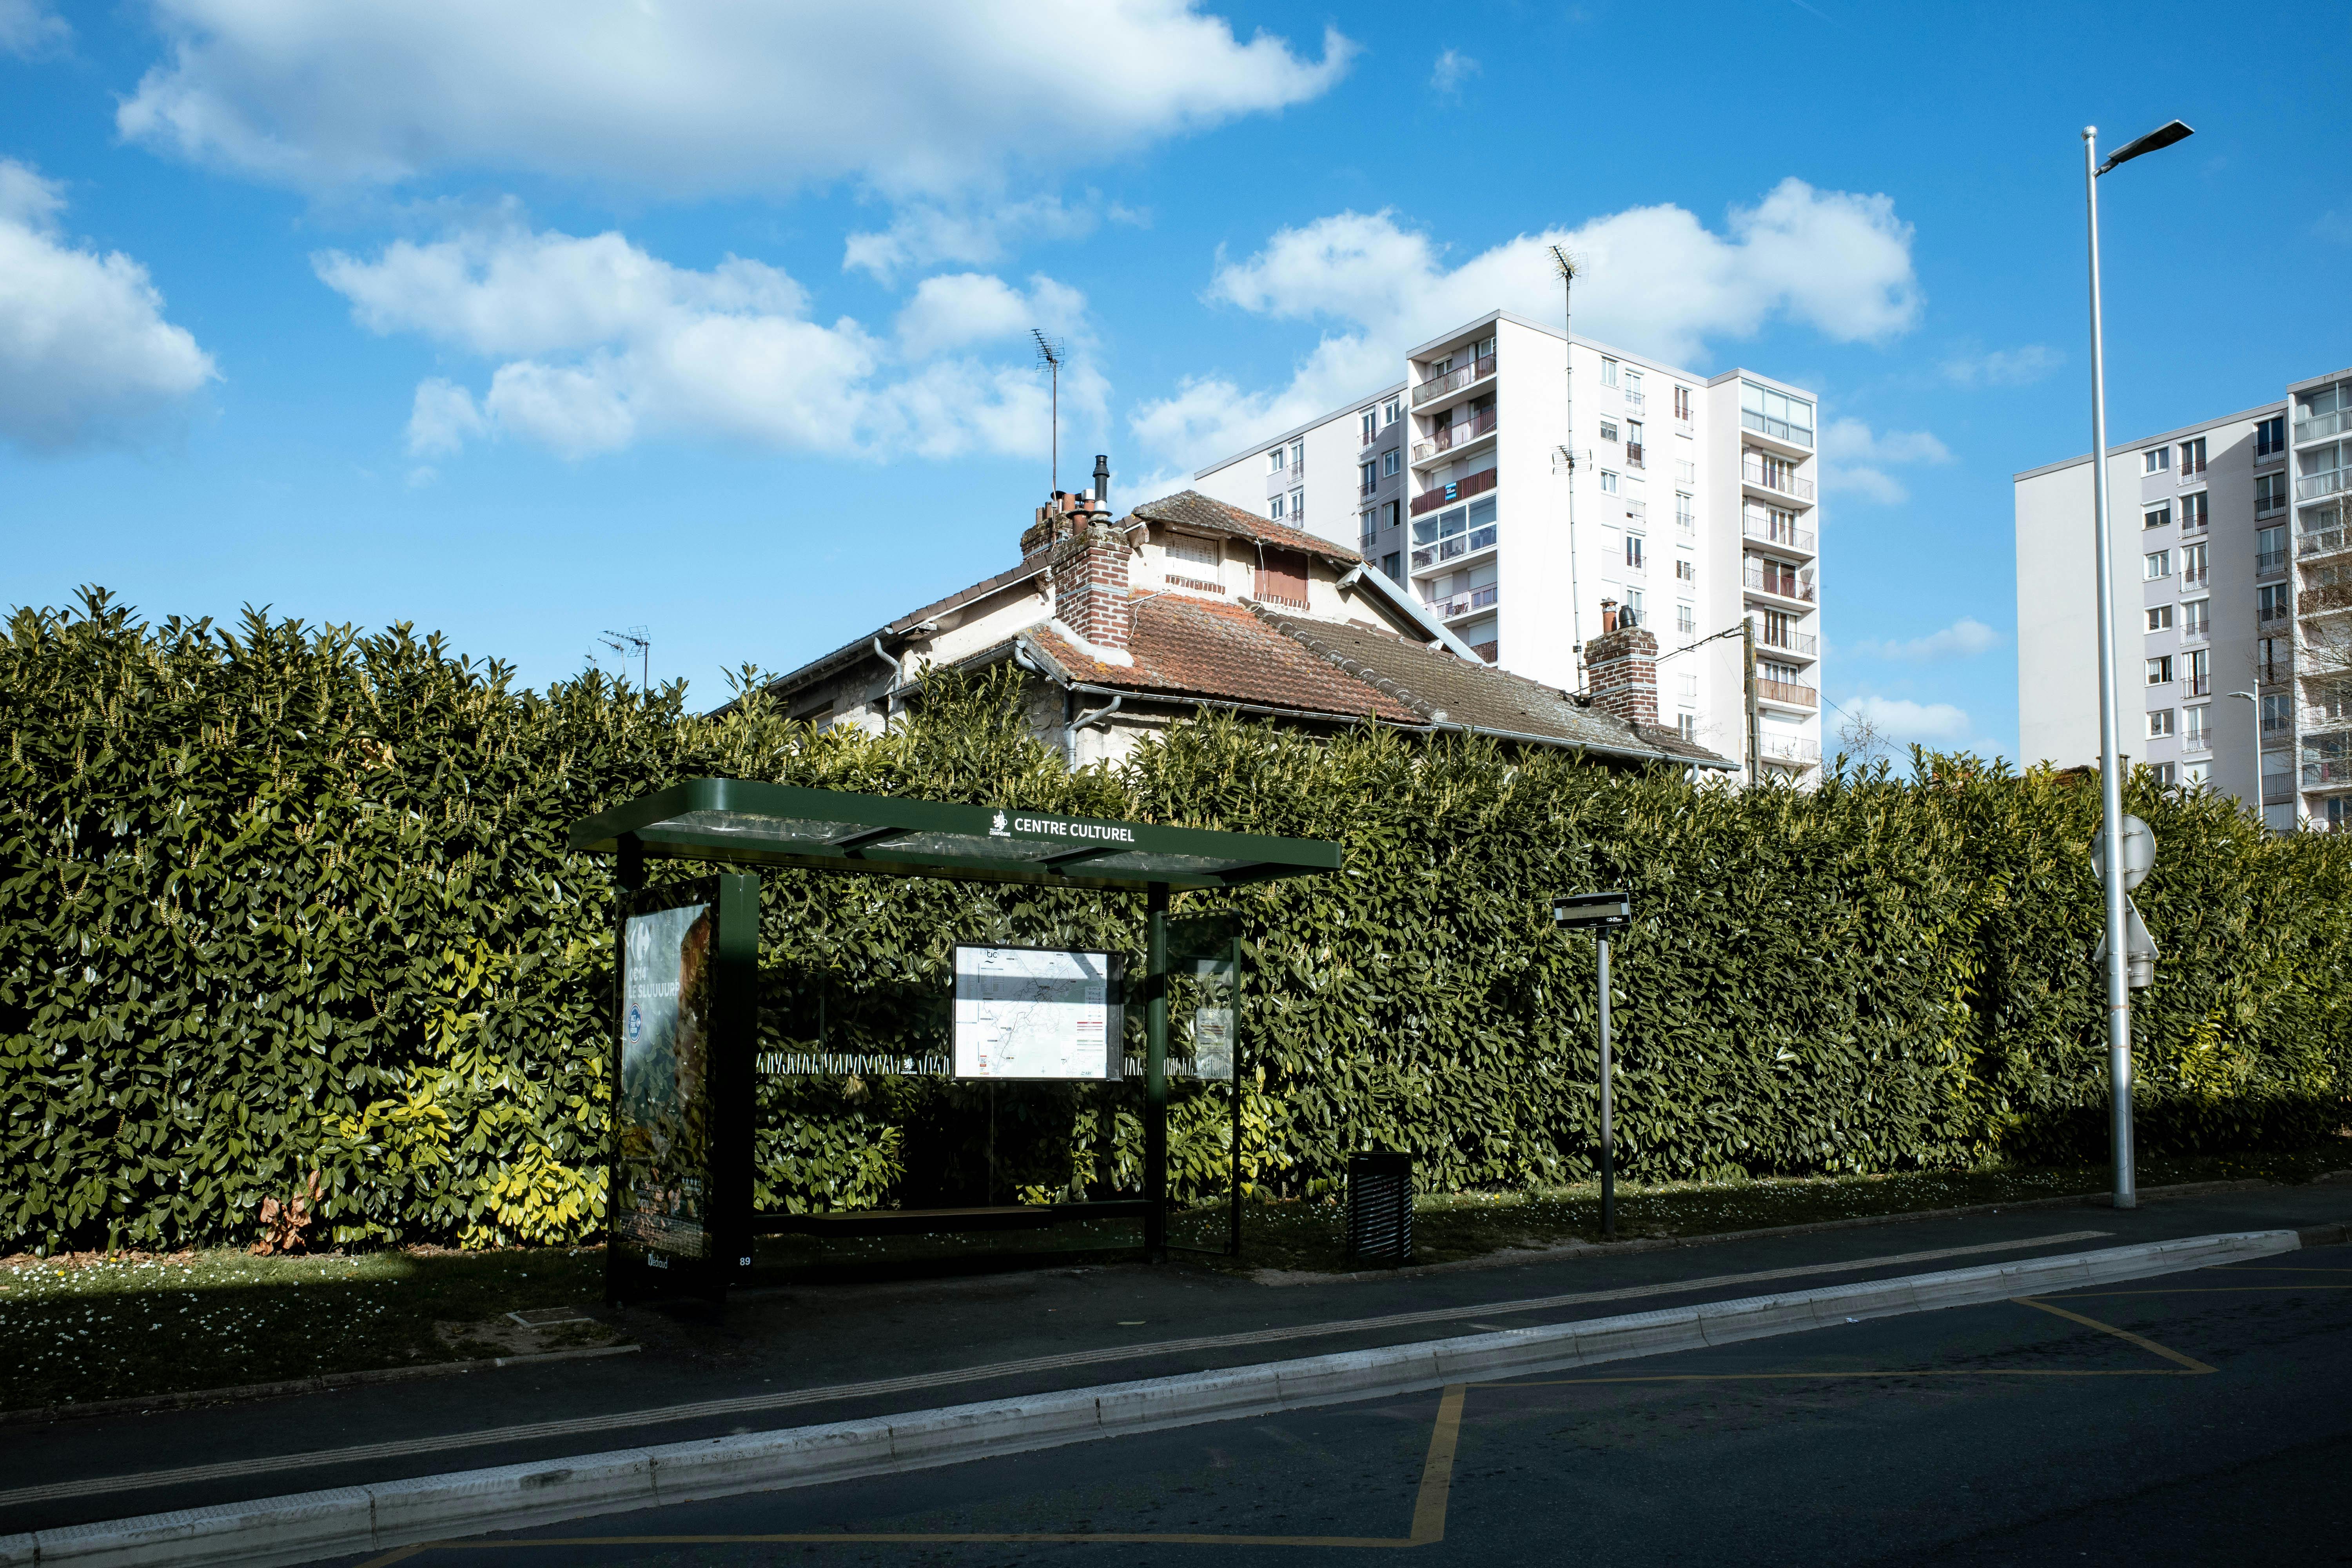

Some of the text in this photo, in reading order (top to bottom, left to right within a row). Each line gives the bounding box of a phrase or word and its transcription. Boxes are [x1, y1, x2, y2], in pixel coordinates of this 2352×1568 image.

[1014, 818, 1135, 842] CENTRE CULTUREL
[628, 982, 680, 999] LE SLUUUURP
[740, 1257, 751, 1266] 89
